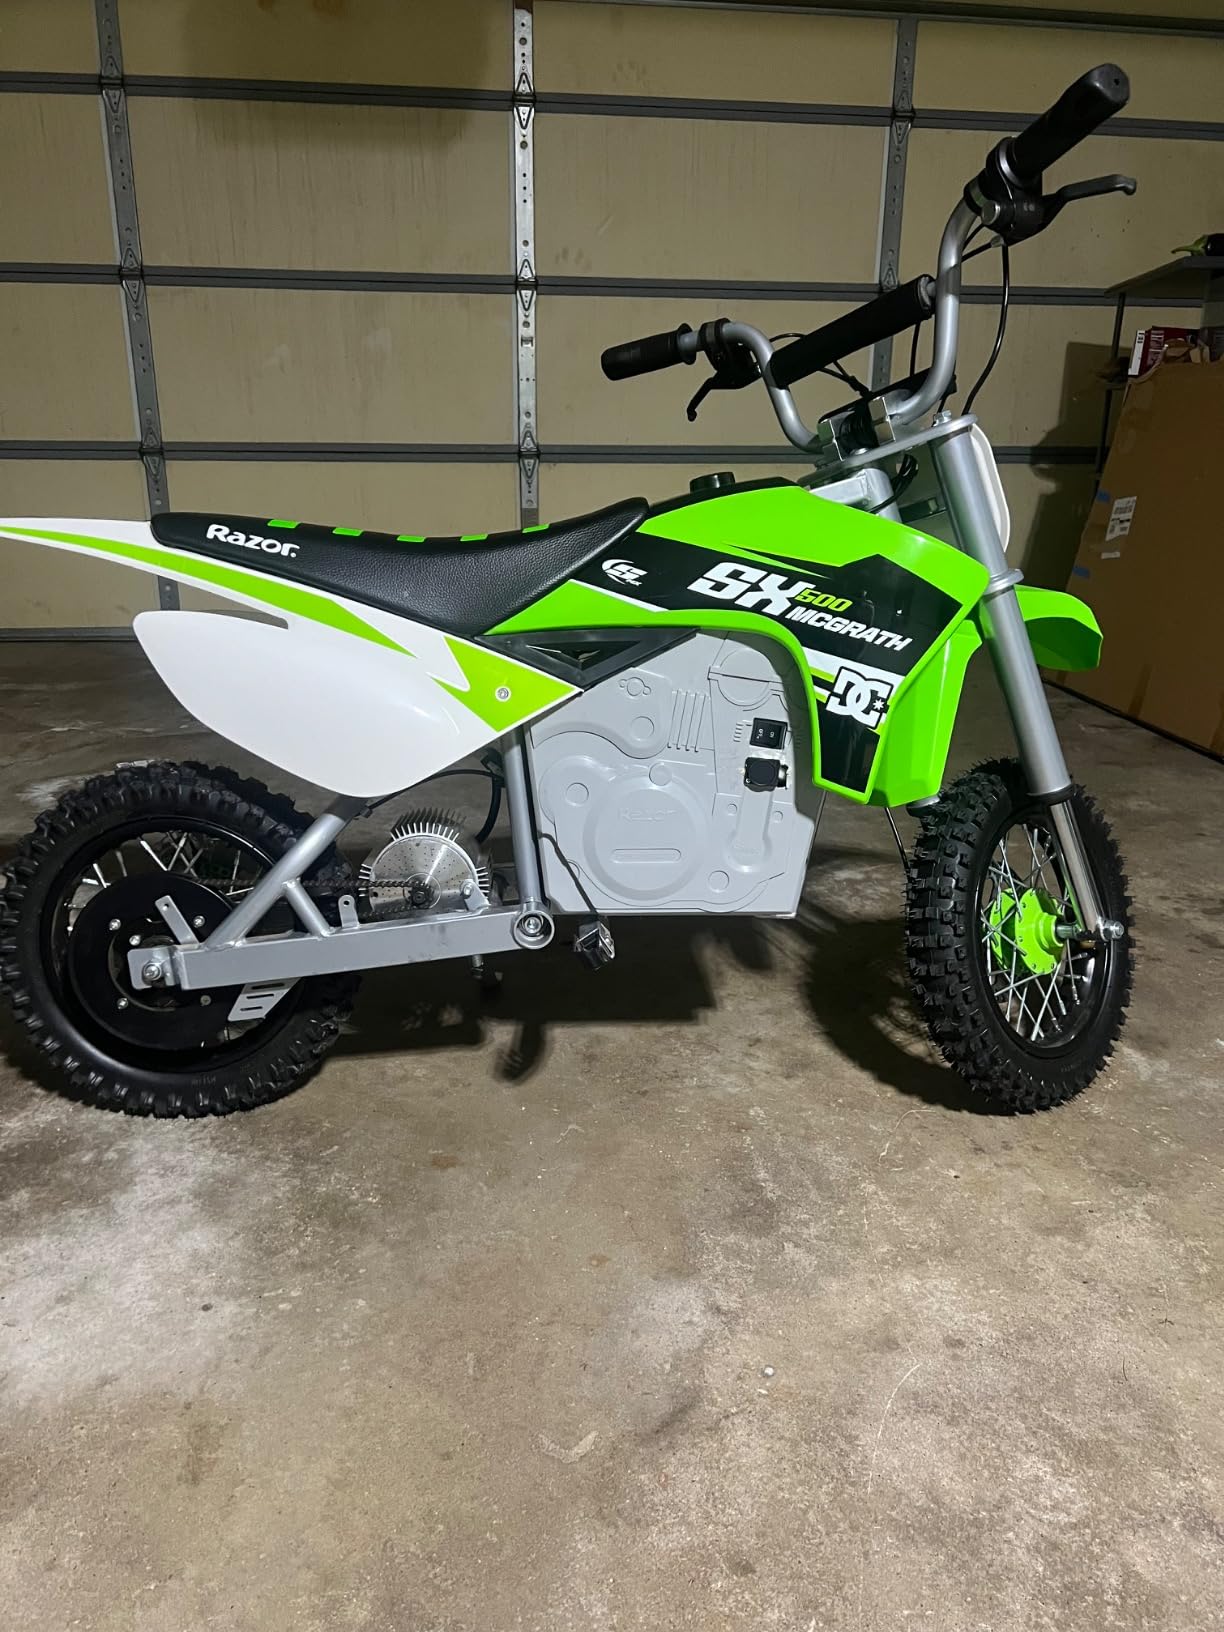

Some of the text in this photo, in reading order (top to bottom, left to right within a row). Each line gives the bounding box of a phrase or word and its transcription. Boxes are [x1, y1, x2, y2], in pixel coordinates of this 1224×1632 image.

[687, 562, 816, 616] SX
[794, 588, 853, 612] 500
[785, 605, 913, 651] MCGRATH
[825, 667, 894, 729] DC
